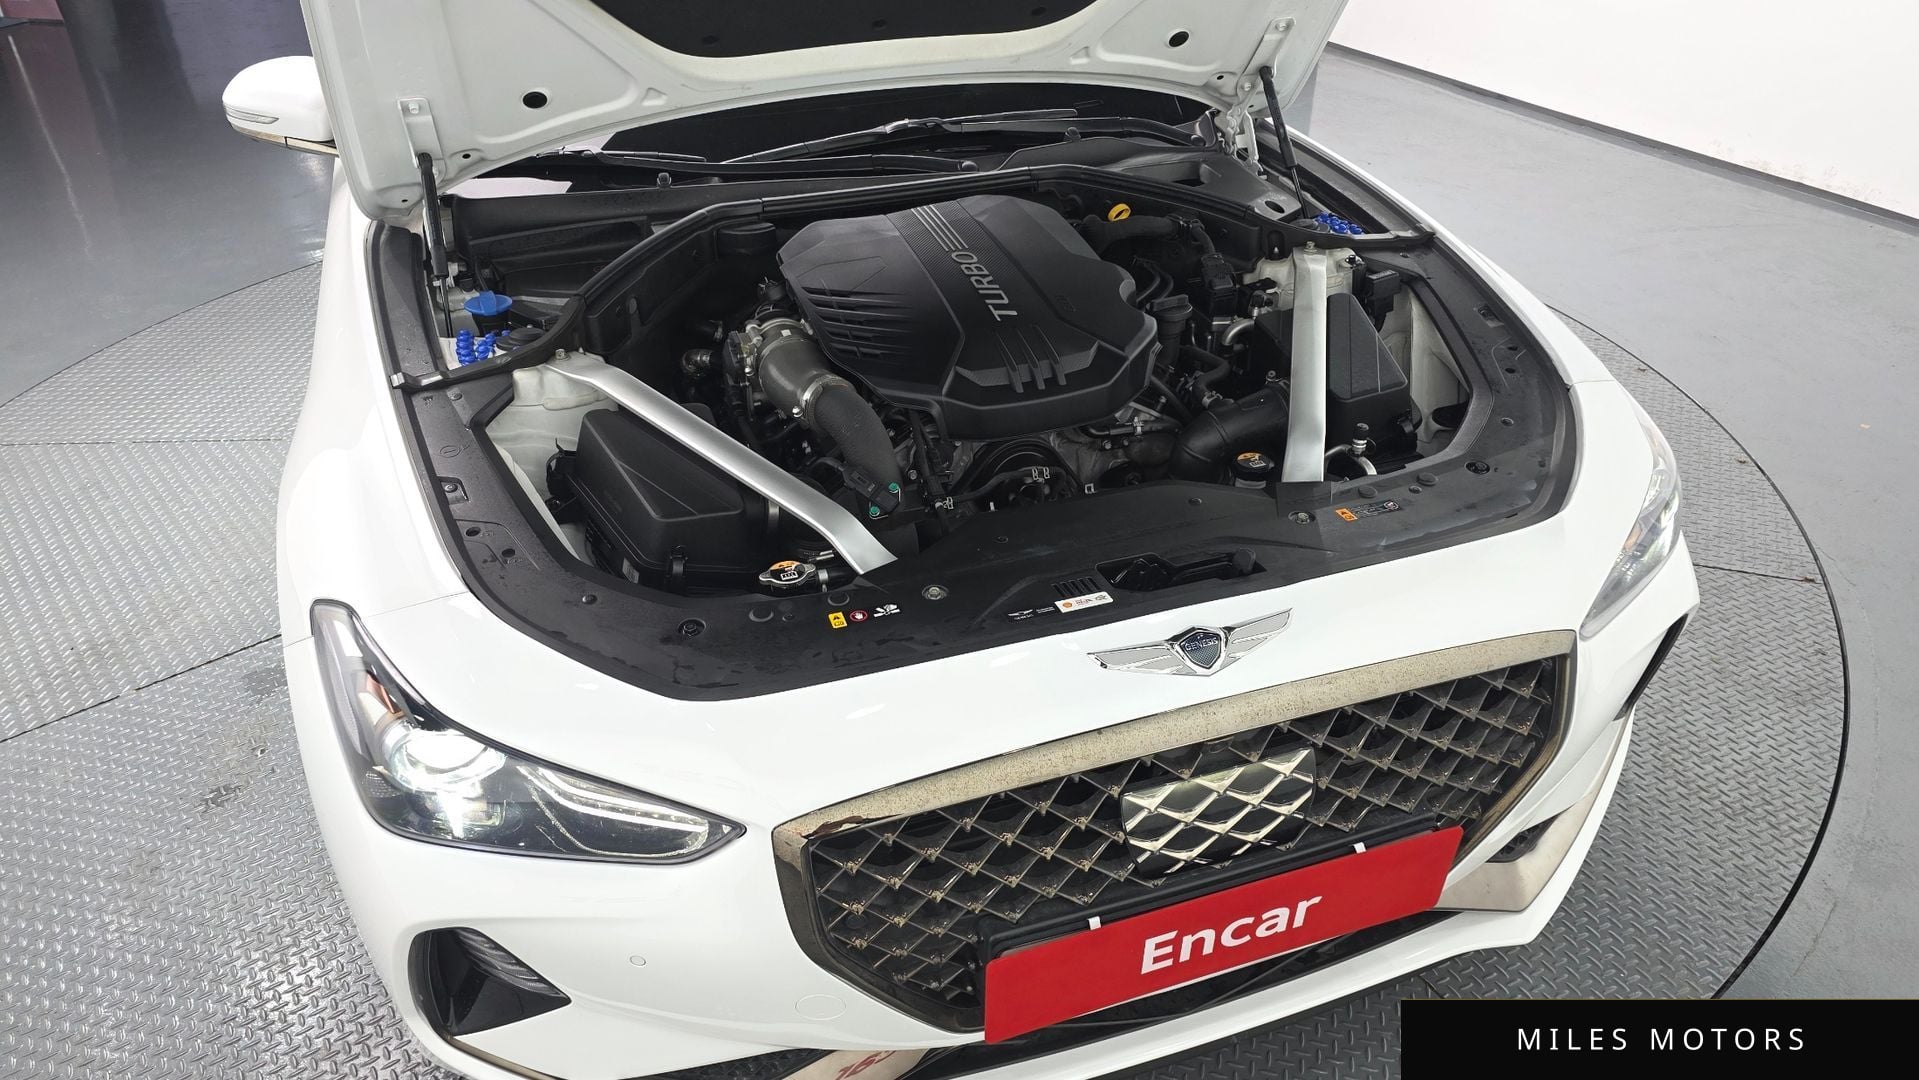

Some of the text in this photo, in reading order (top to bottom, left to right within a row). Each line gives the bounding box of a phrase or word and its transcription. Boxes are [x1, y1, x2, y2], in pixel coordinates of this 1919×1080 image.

[951, 250, 1018, 322] TURBO
[1184, 637, 1219, 651] GENESIS
[1140, 895, 1322, 975] Encar
